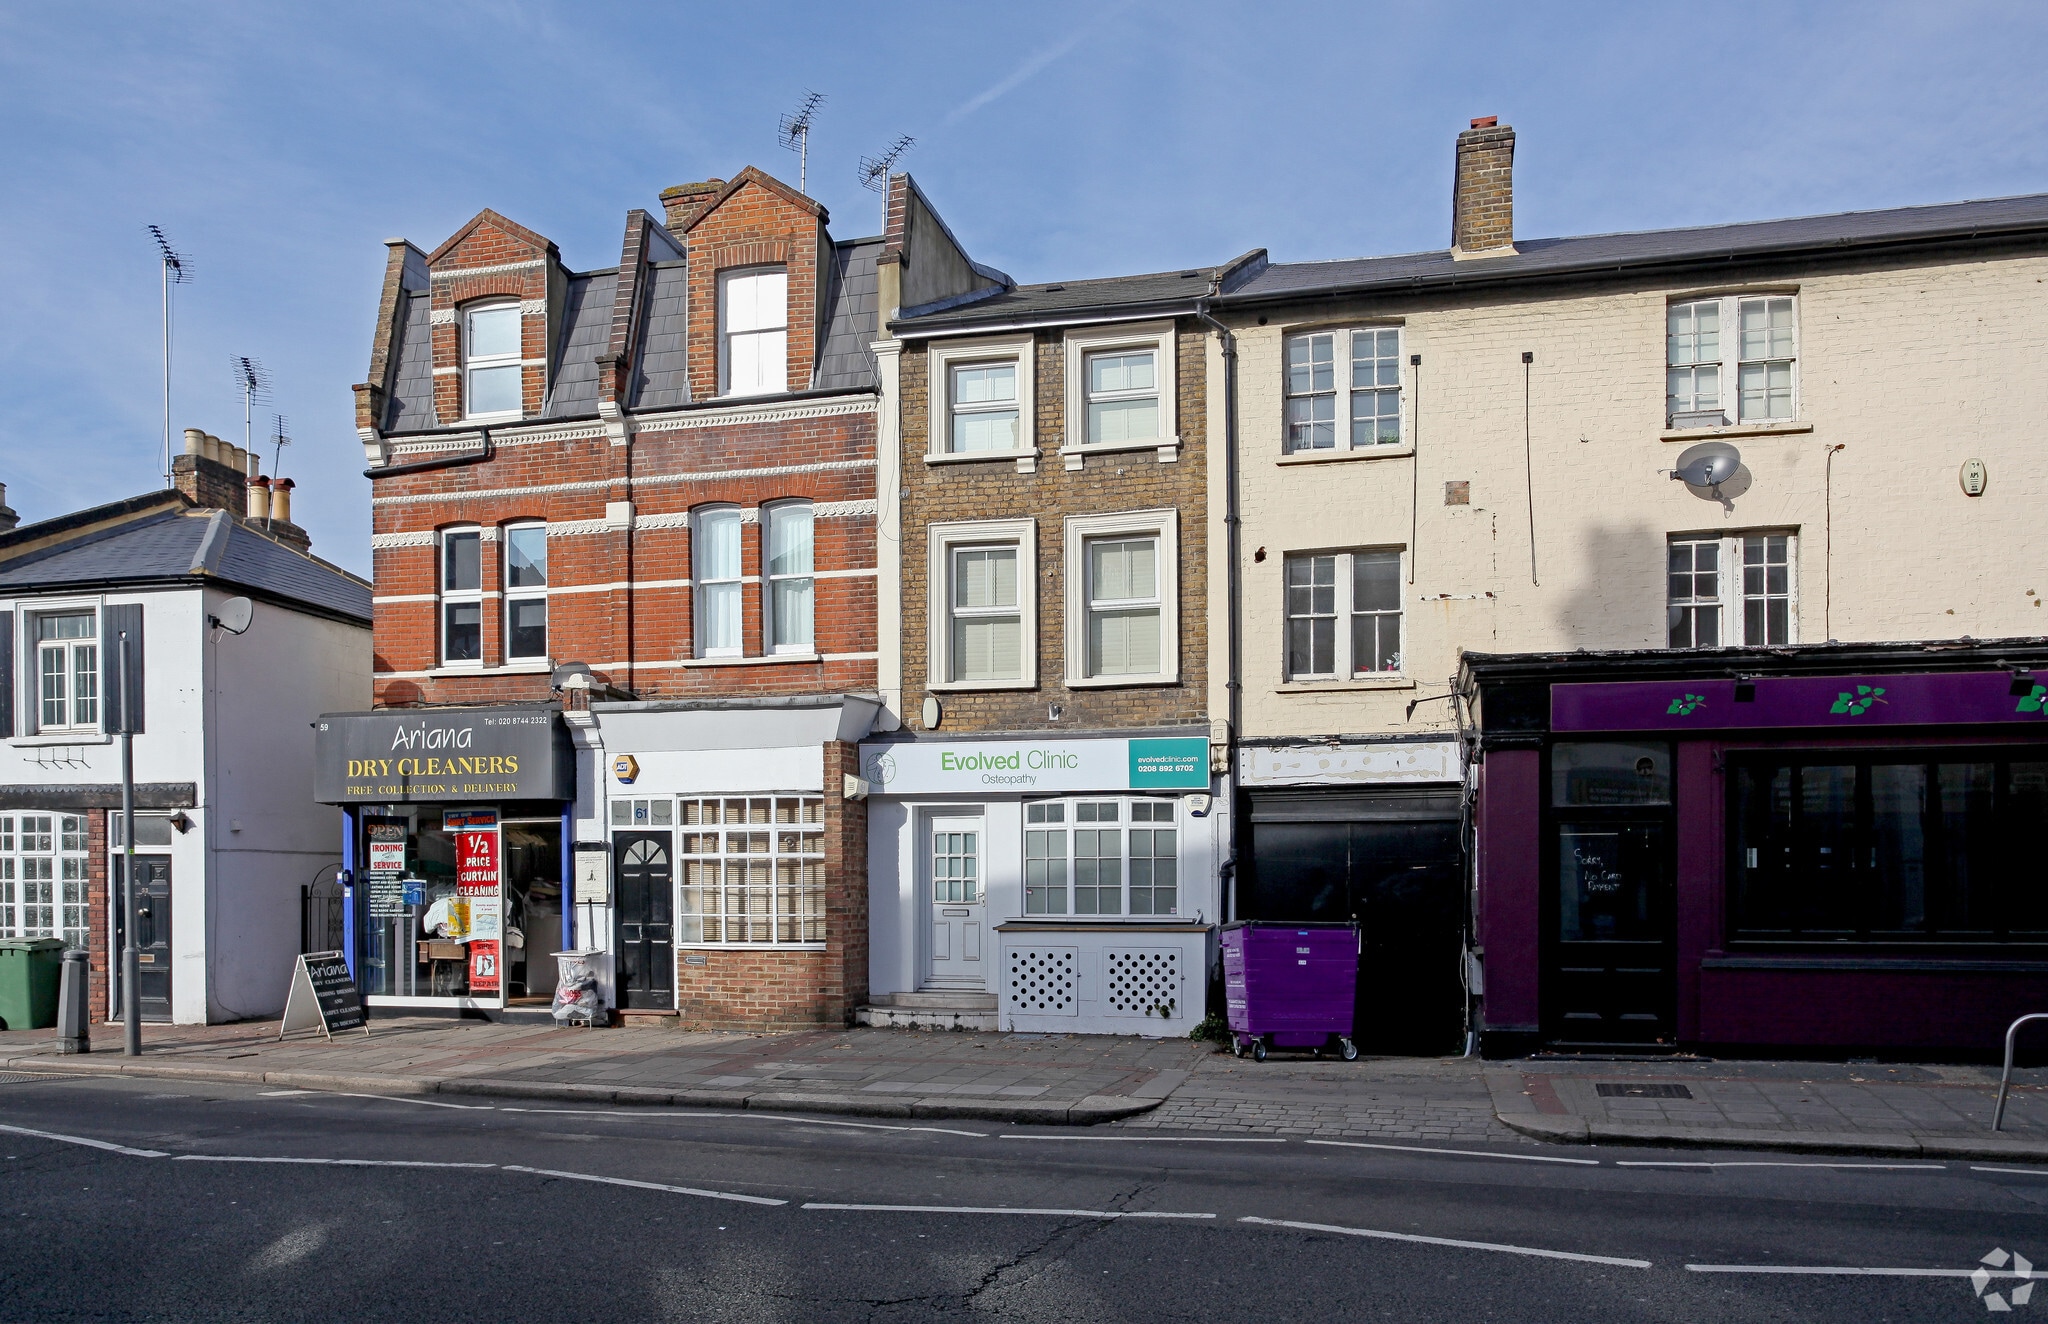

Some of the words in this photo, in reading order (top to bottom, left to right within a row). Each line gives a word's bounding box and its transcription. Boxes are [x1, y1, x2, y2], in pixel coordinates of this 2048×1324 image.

[391, 721, 473, 750] Ariana
[348, 759, 393, 777] DRY
[398, 755, 519, 776] CLEANERS
[941, 751, 1020, 770] Evolved
[1028, 750, 1078, 769] Clinic
[981, 773, 1037, 786] Osteopathy
[347, 786, 373, 795] FREE
[378, 784, 445, 794] COLLECTION
[451, 785, 458, 793] &
[464, 783, 518, 793] DELIVERY
[636, 808, 648, 818] 61
[467, 816, 495, 824] SERVICE
[368, 824, 404, 836] OPEN
[372, 844, 403, 852] IRONING
[468, 834, 488, 854] 1/2
[466, 857, 490, 867] PRICE
[461, 871, 497, 882] CURTAIN
[459, 885, 499, 896] CLEANING
[310, 962, 348, 978] Ariana
